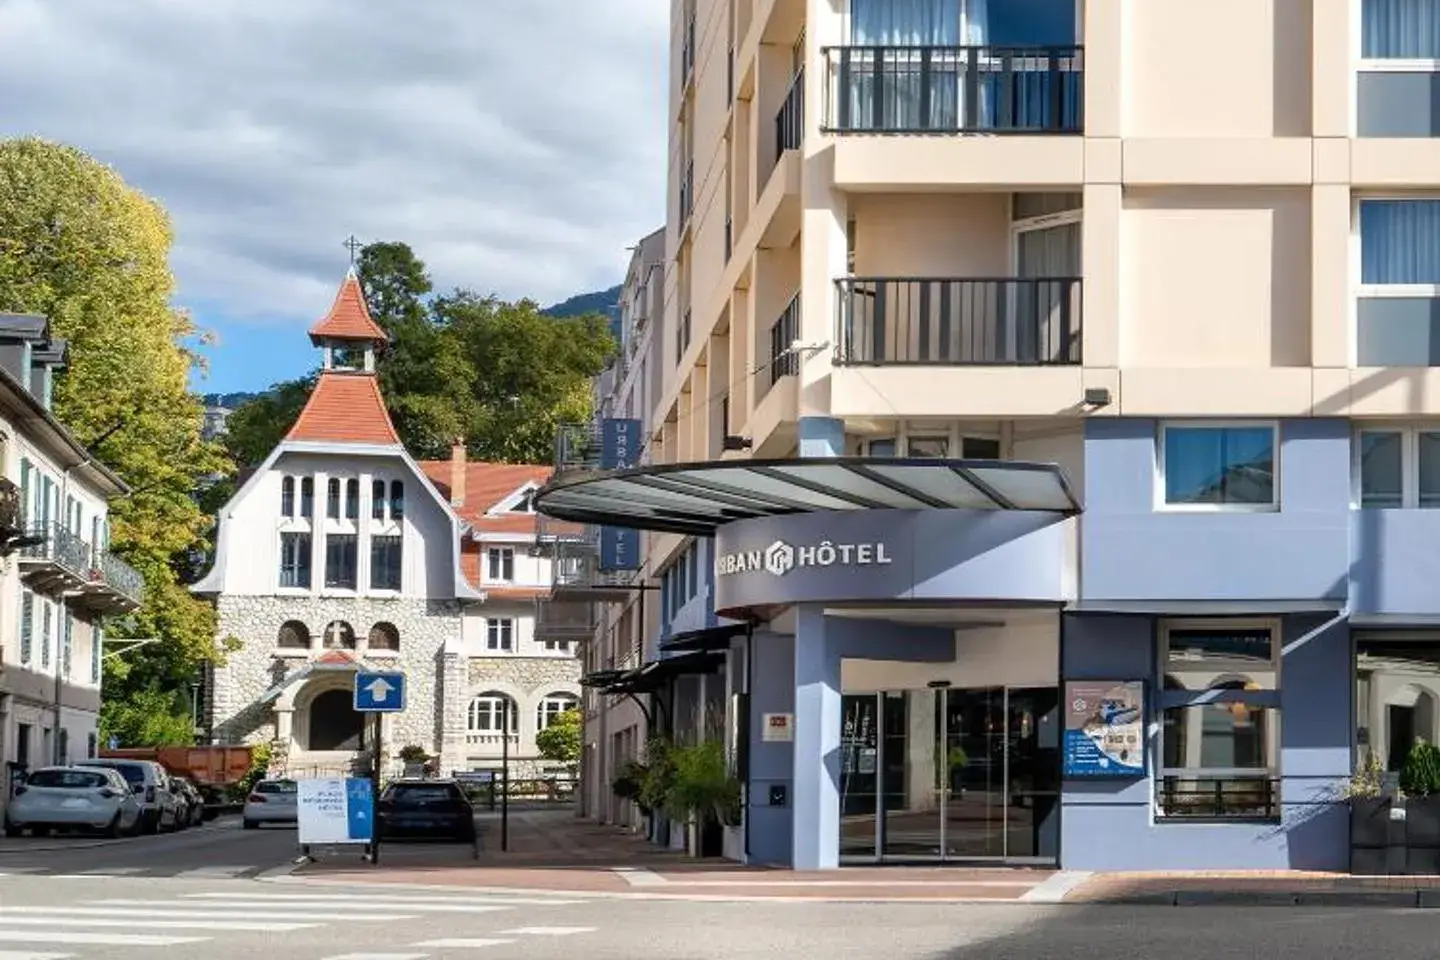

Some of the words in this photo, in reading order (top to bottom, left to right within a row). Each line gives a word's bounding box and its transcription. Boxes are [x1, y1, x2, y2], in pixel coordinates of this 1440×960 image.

[615, 423, 628, 470] URBA
[615, 531, 627, 566] TEL
[714, 550, 761, 576] RBAN
[798, 541, 892, 566] HÔTEL
